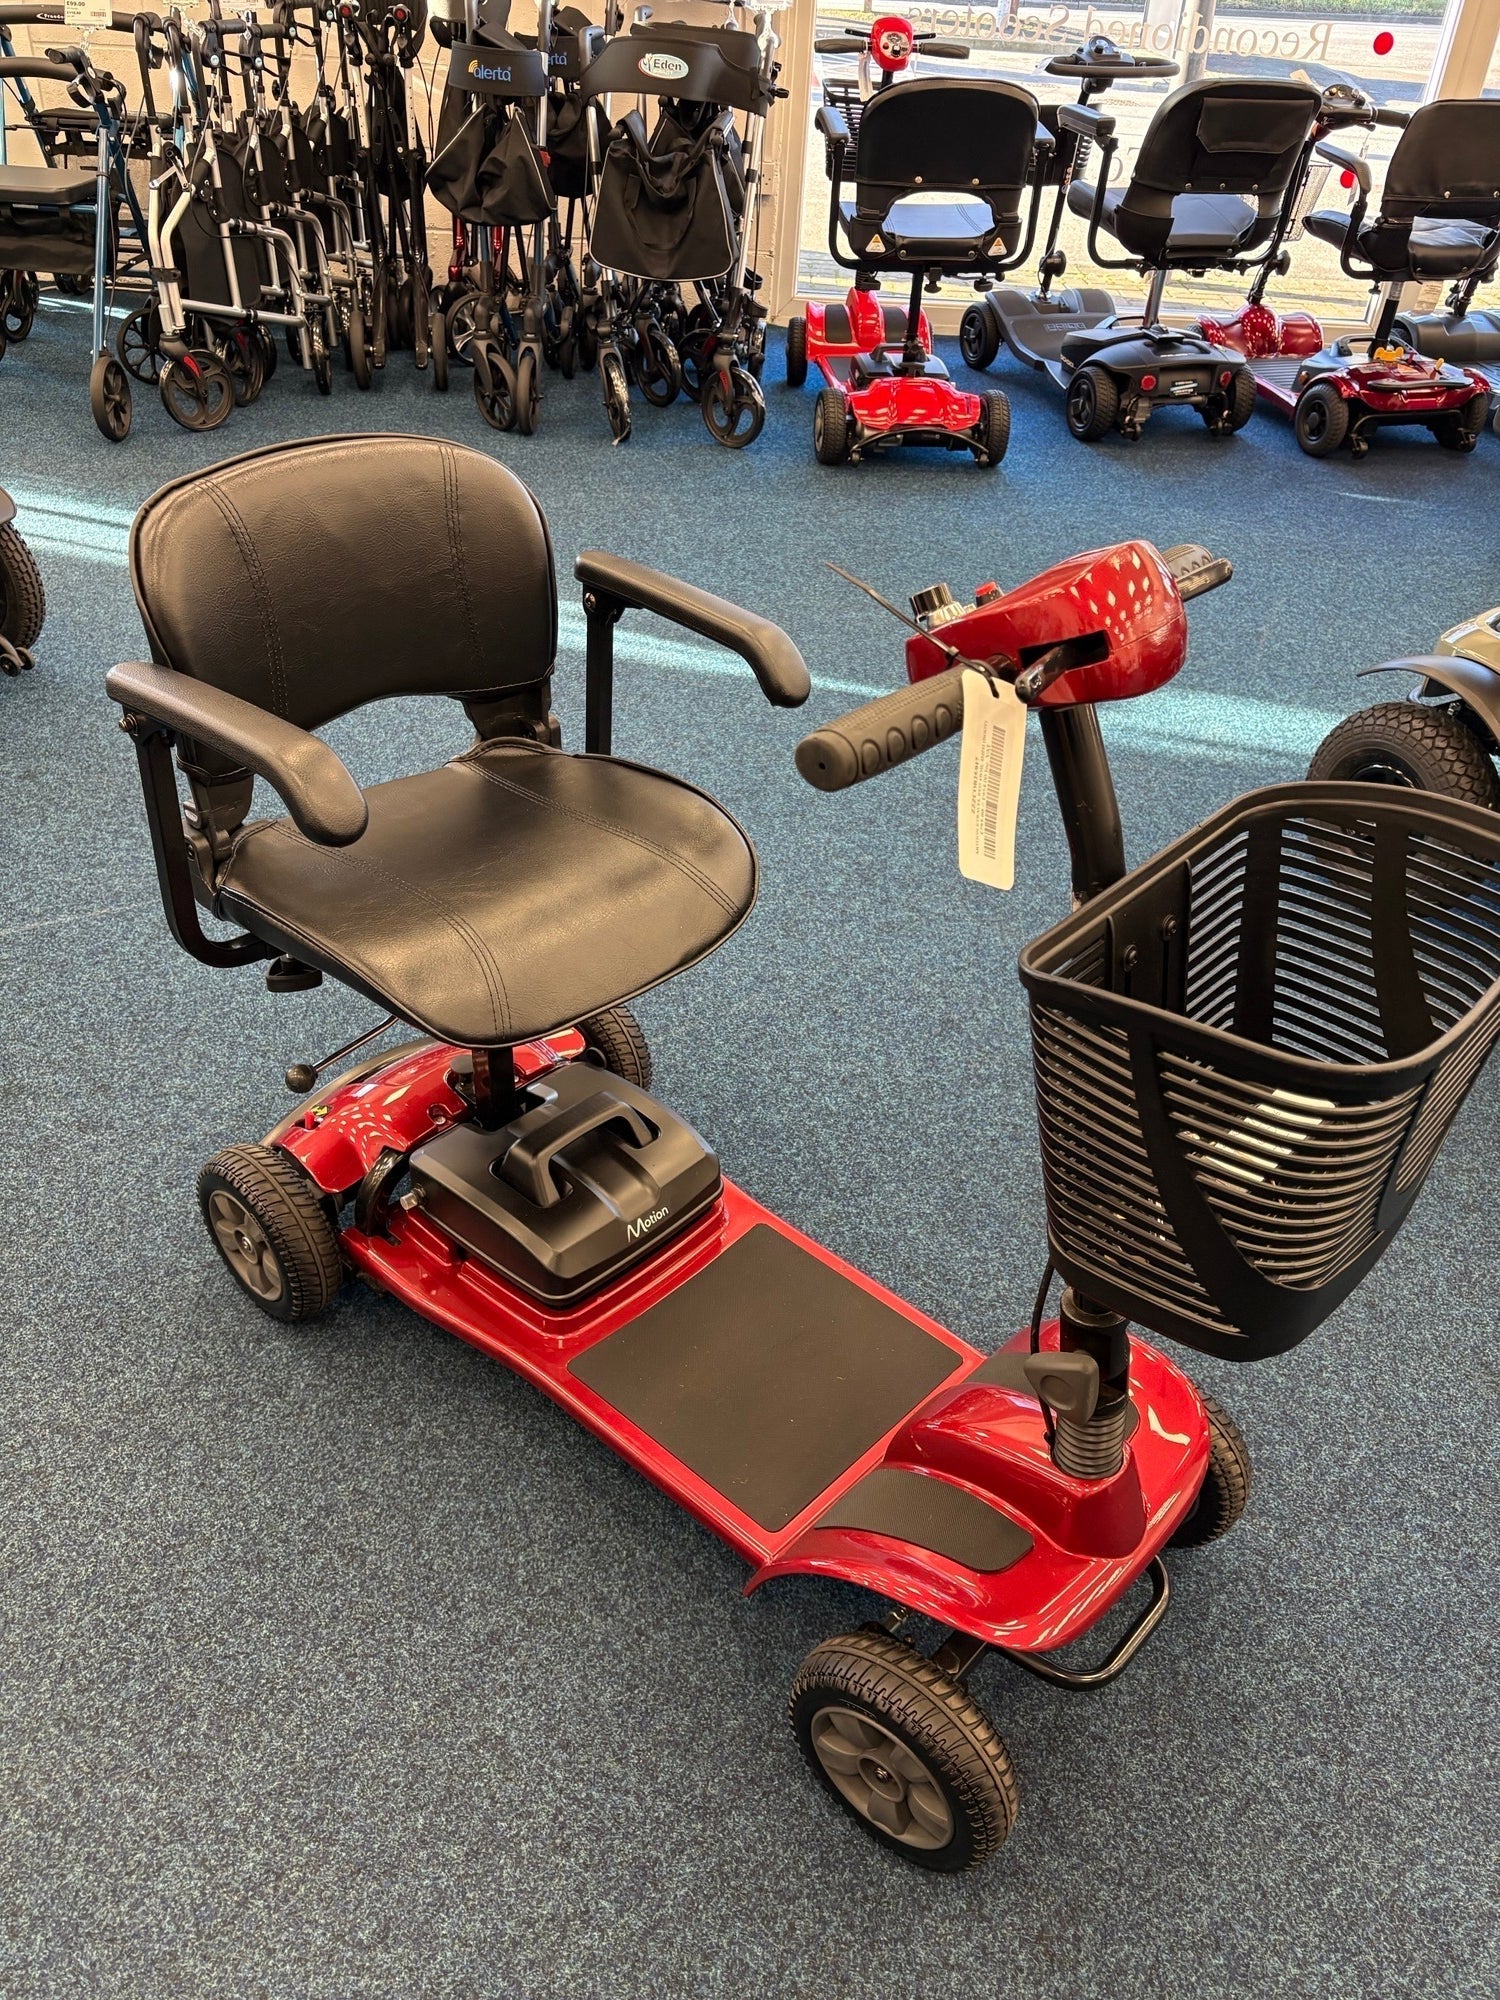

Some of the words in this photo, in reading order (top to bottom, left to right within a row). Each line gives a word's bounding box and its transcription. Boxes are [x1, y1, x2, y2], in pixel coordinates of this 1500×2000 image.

[548, 53, 568, 66] rta
[653, 58, 682, 71] Eden
[473, 64, 512, 82] alerta
[626, 1206, 669, 1243] Motion
